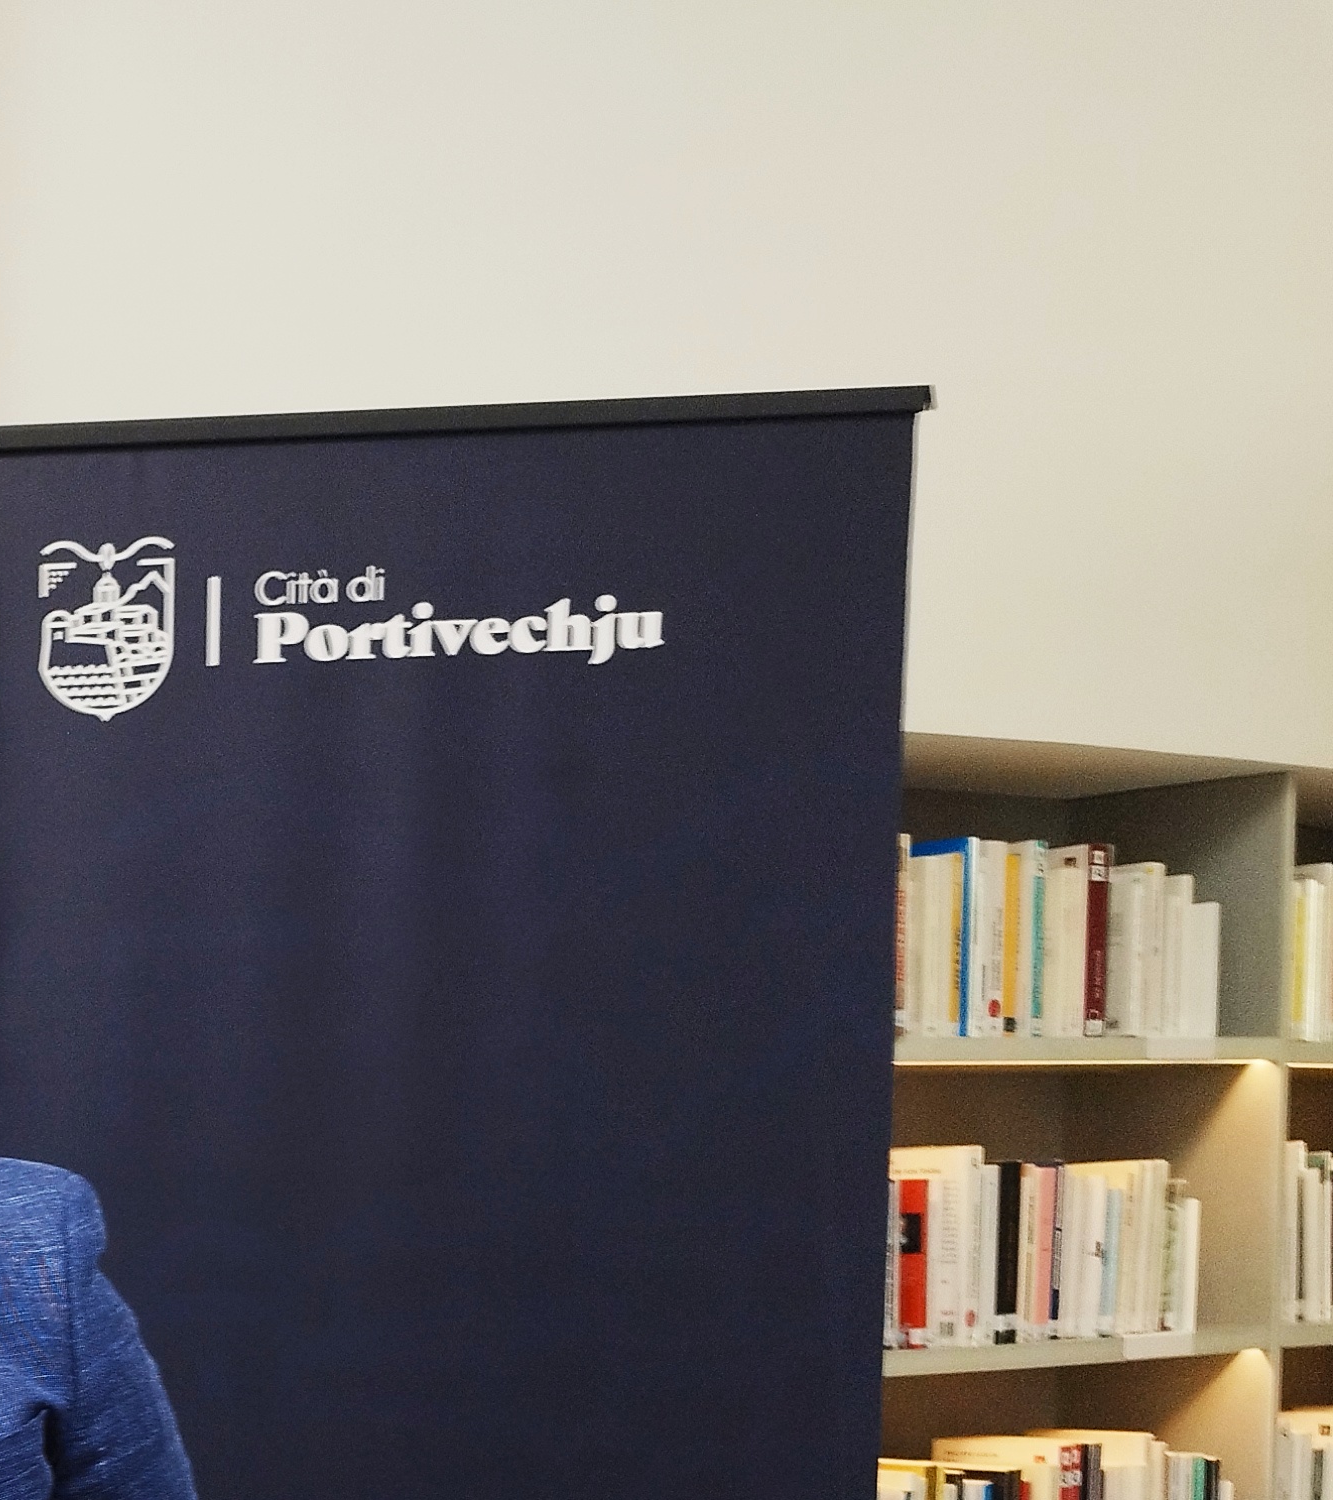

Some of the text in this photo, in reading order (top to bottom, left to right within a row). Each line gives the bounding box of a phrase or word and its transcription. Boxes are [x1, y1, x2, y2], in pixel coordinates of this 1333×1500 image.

[254, 565, 386, 606] Cità di
[253, 595, 665, 666] Portivechju
